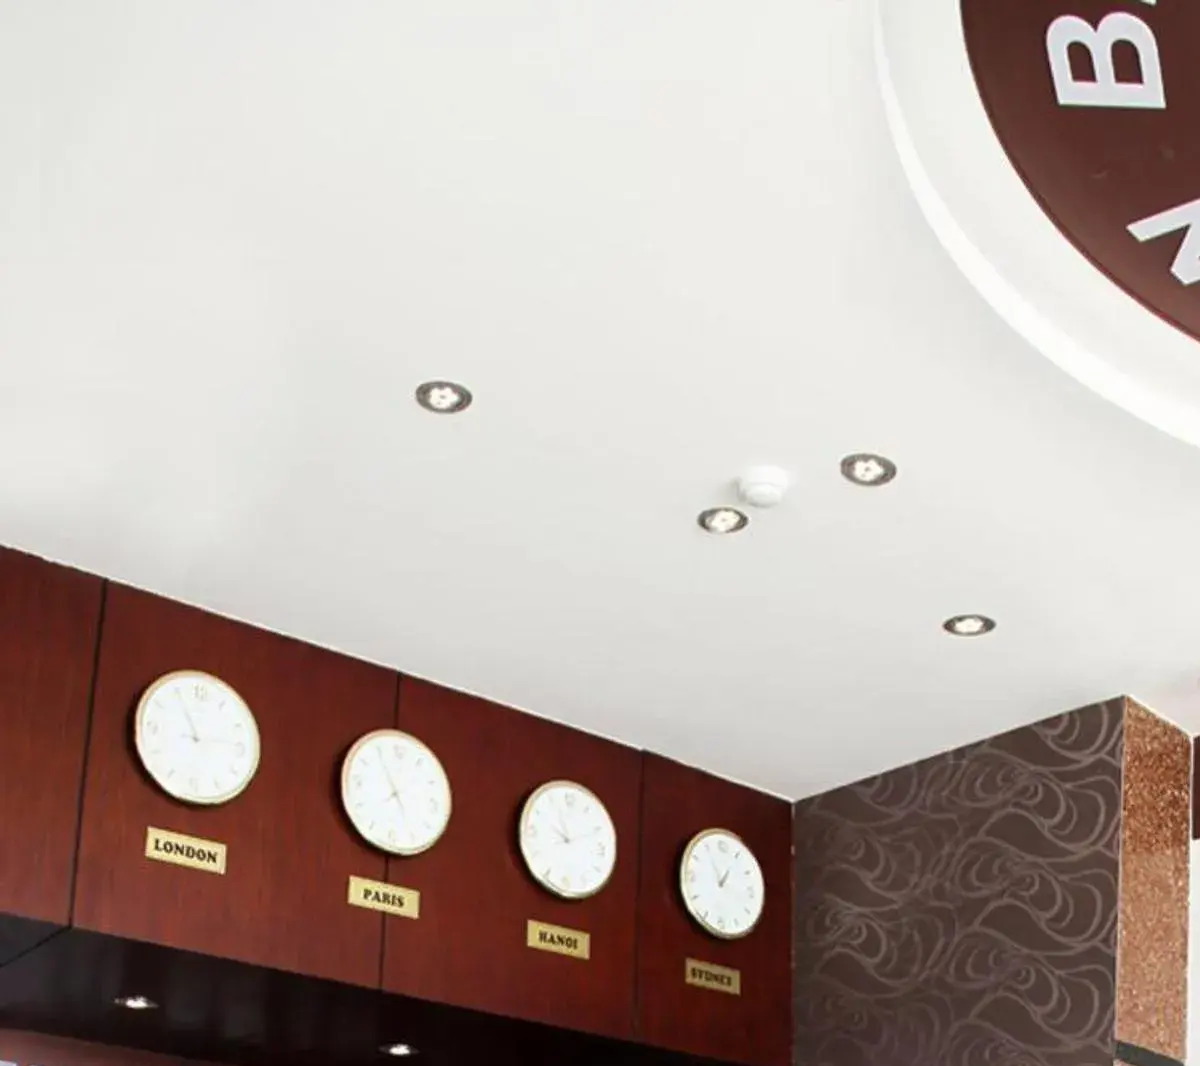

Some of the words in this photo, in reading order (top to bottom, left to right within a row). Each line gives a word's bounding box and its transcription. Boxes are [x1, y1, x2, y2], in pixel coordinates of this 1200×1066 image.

[154, 838, 218, 864] LONDON
[363, 888, 405, 908] PARIS
[538, 930, 578, 950] HANOI
